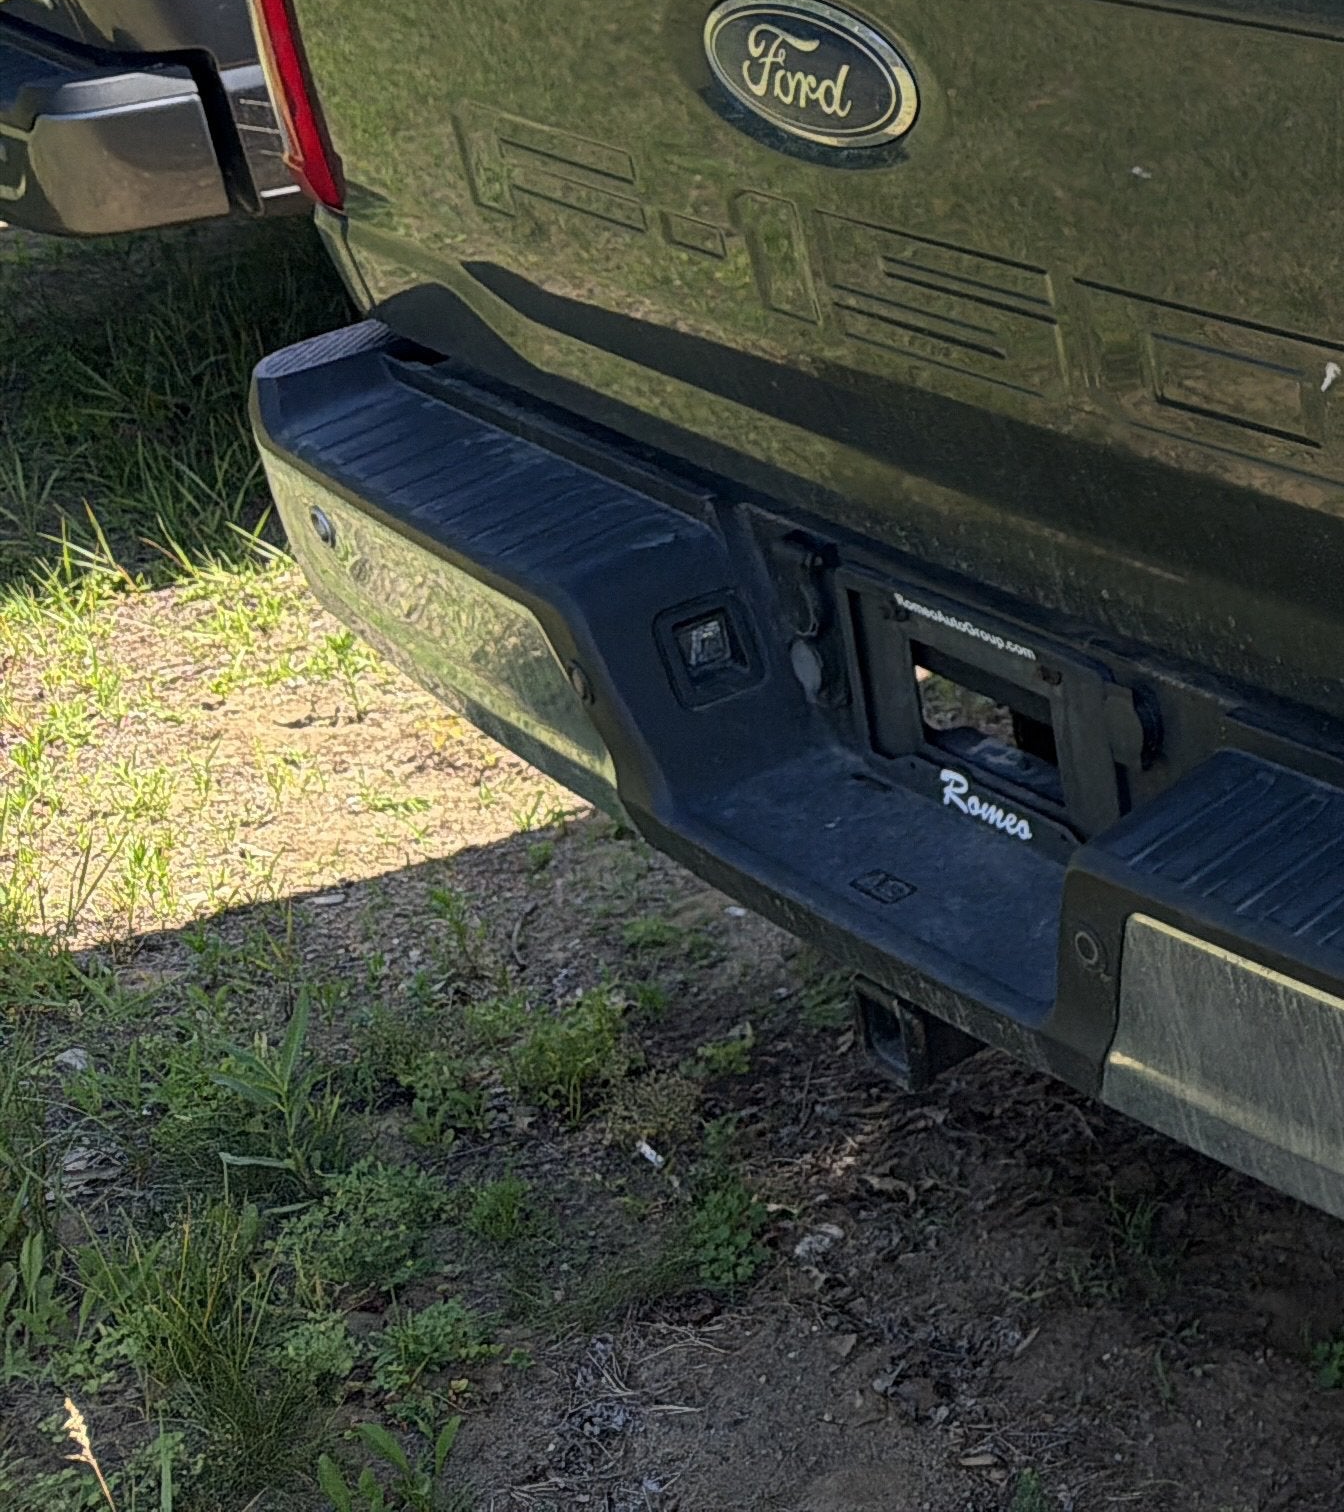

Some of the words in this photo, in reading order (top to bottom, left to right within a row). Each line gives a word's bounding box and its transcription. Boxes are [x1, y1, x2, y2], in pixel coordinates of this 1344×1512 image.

[742, 23, 851, 118] Ford
[894, 592, 1036, 661] RomeoAutoGroup.com
[940, 768, 1033, 840] Romeo
